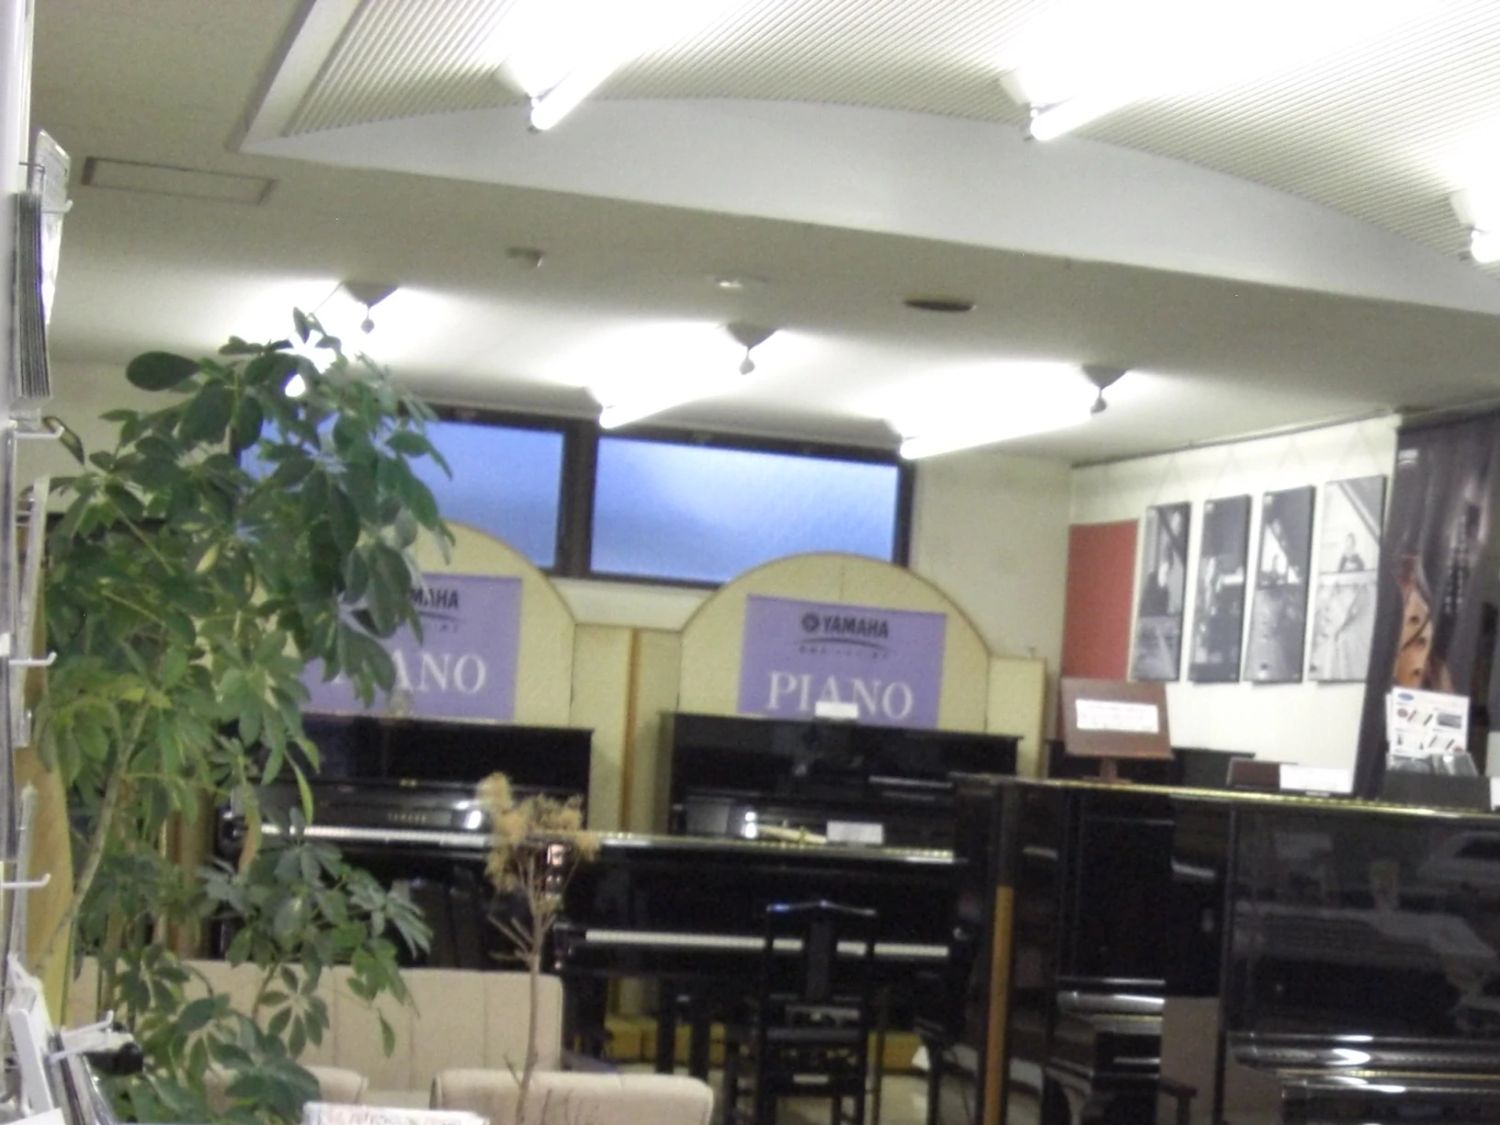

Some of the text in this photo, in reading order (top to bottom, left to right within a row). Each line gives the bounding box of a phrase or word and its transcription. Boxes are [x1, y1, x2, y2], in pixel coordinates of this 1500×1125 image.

[409, 588, 459, 609] MAHA
[822, 615, 889, 638] YAMAHA
[766, 671, 914, 720] PIANO
